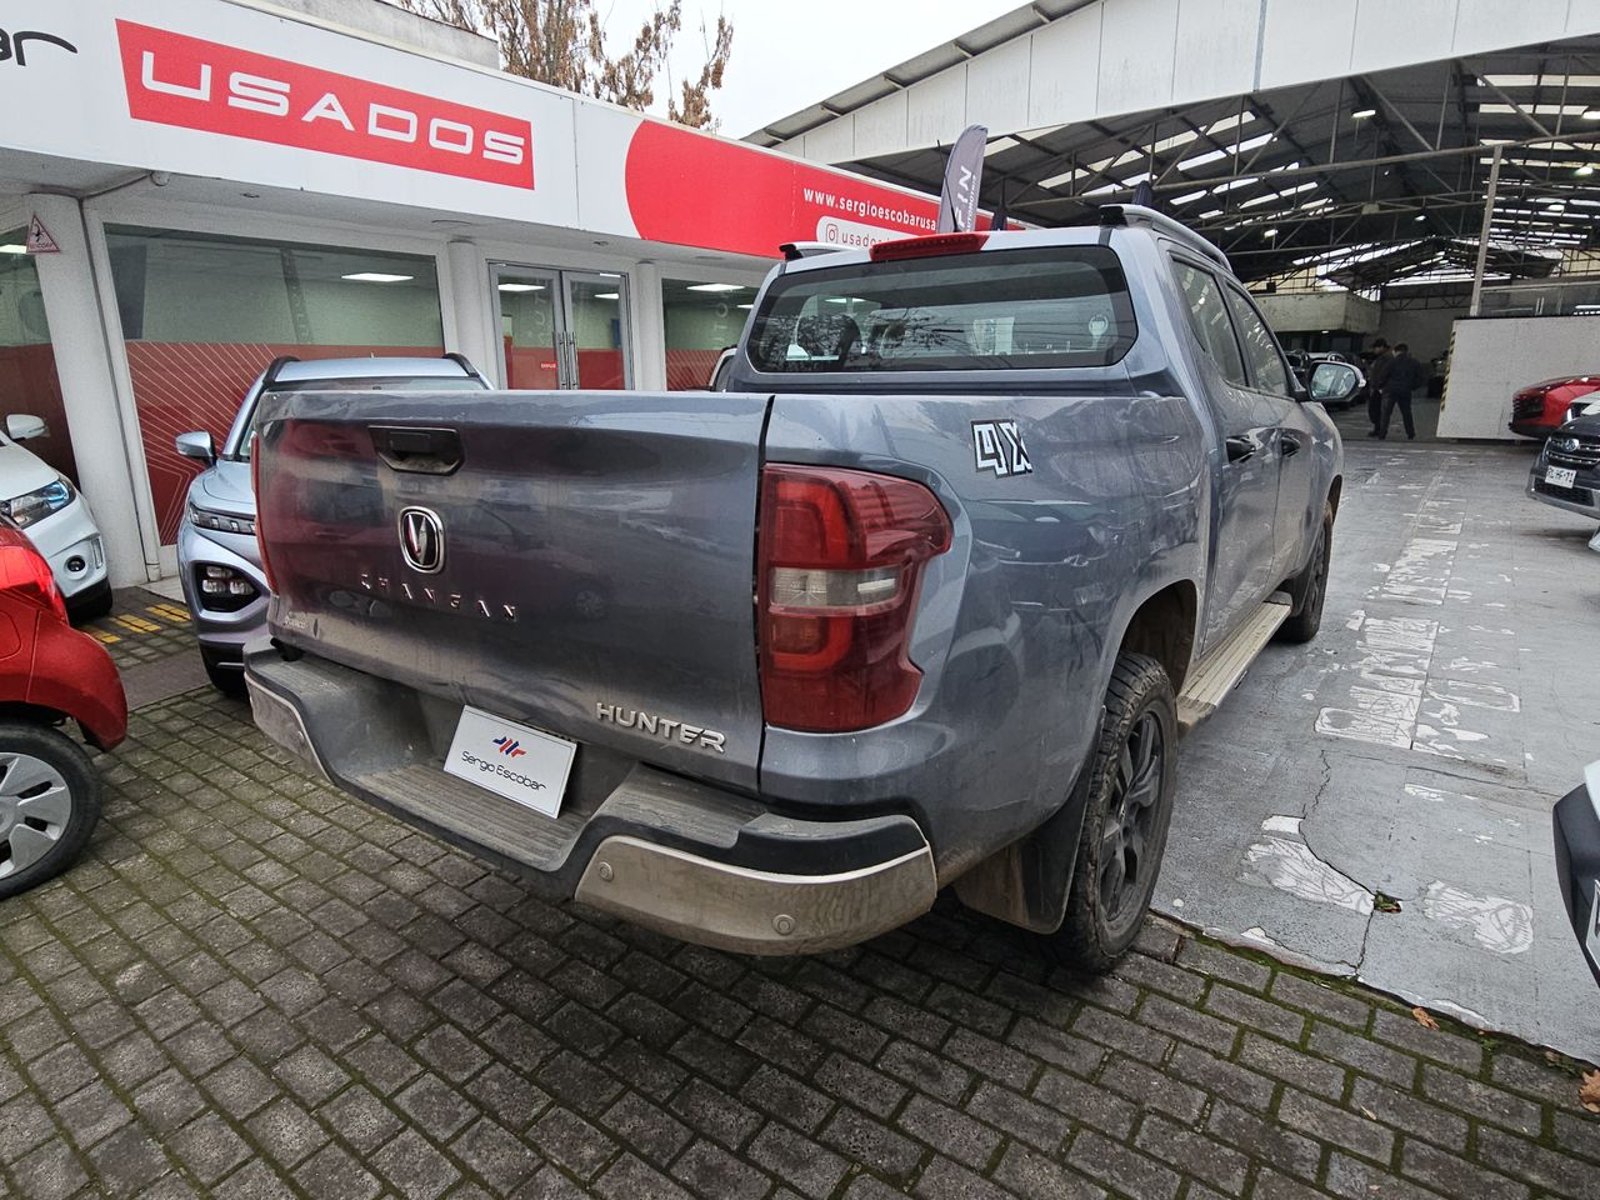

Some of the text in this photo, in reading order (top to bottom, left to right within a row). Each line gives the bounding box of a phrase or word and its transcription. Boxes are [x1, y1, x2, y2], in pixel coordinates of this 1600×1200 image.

[142, 51, 525, 164] USADOS
[596, 702, 725, 753] HUNTER
[495, 765, 547, 791] Escobar
